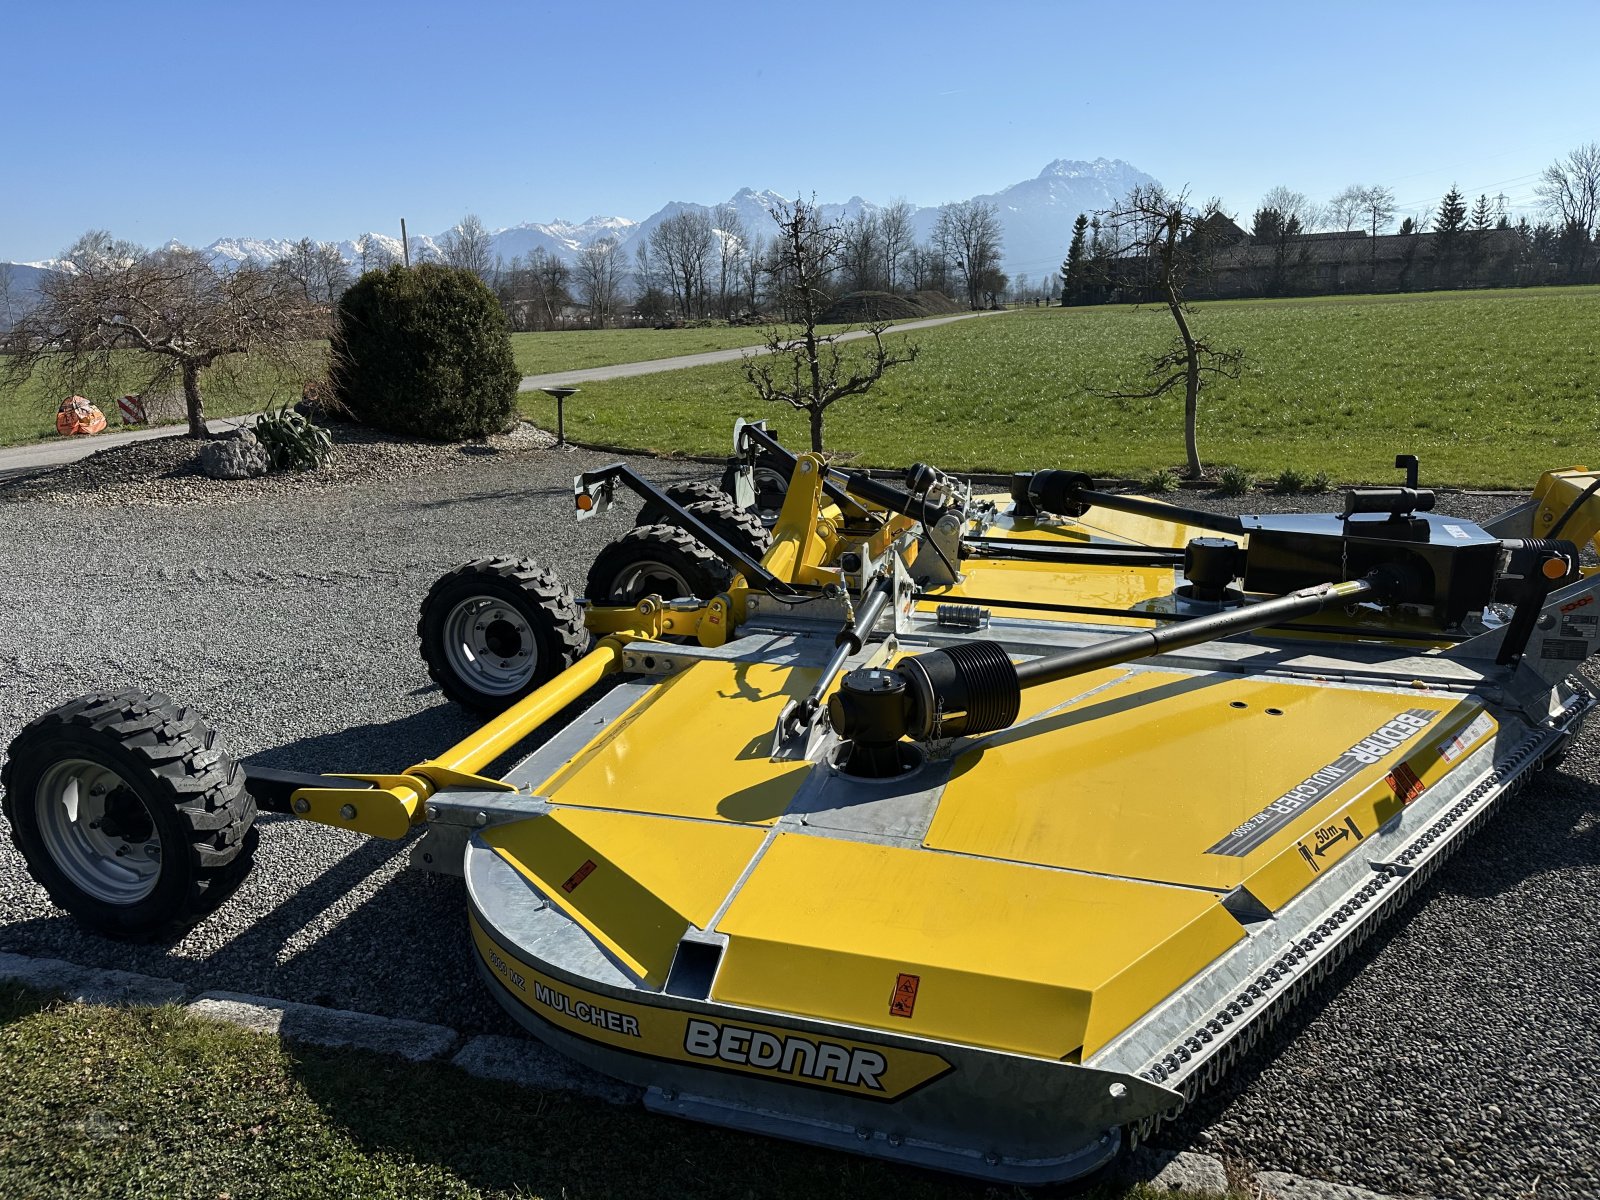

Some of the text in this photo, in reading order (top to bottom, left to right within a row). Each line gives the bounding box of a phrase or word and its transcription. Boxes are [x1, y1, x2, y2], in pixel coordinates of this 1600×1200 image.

[1333, 713, 1430, 763] BEDNAR
[1267, 765, 1346, 814] MULCHER
[1314, 825, 1338, 844] 50m
[510, 968, 526, 991] MZ
[534, 981, 641, 1037] MULCHER
[685, 1019, 887, 1091] BEDNAR
